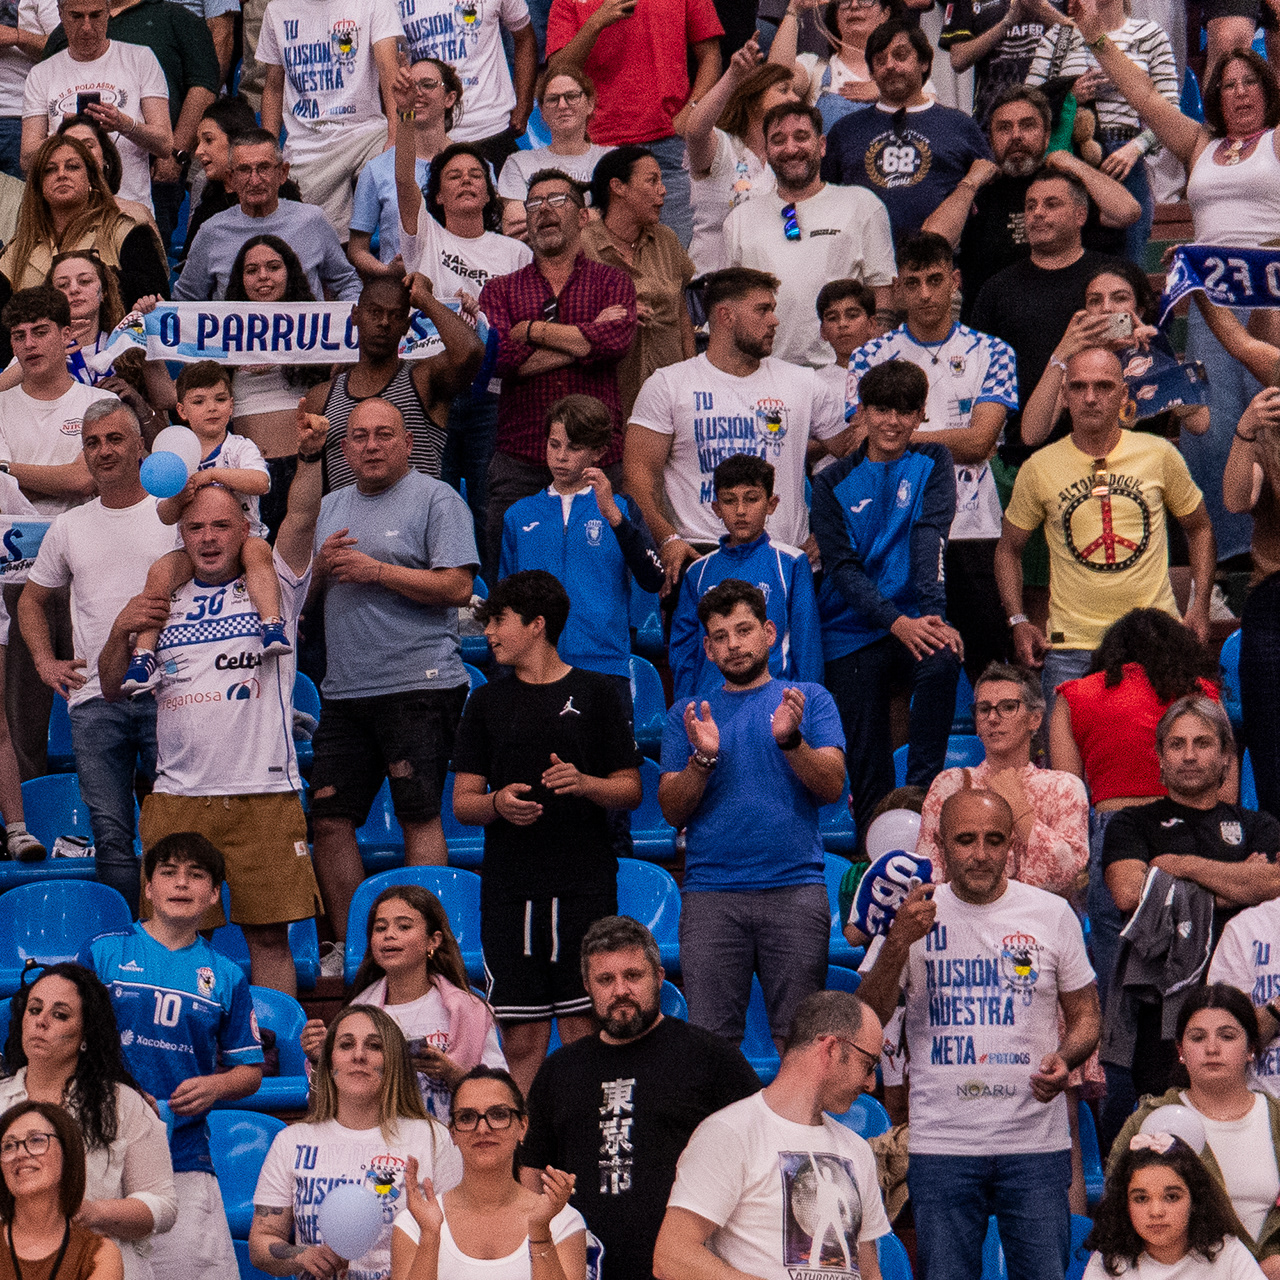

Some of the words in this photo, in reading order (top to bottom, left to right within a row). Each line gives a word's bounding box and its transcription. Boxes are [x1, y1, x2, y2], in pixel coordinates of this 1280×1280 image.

[284, 20, 300, 41] TU
[158, 312, 182, 348] O
[693, 391, 713, 411] TU
[693, 413, 756, 442] ILUSIÓN
[185, 588, 227, 620] 30
[925, 955, 999, 989] ILUSIÓN
[153, 989, 182, 1028] 10
[929, 995, 1016, 1027] NUESTRA
[135, 1033, 178, 1052] Xacobeo
[930, 1035, 977, 1066] META
[956, 1083, 1017, 1098] NOARU
[294, 1143, 319, 1171] TU
